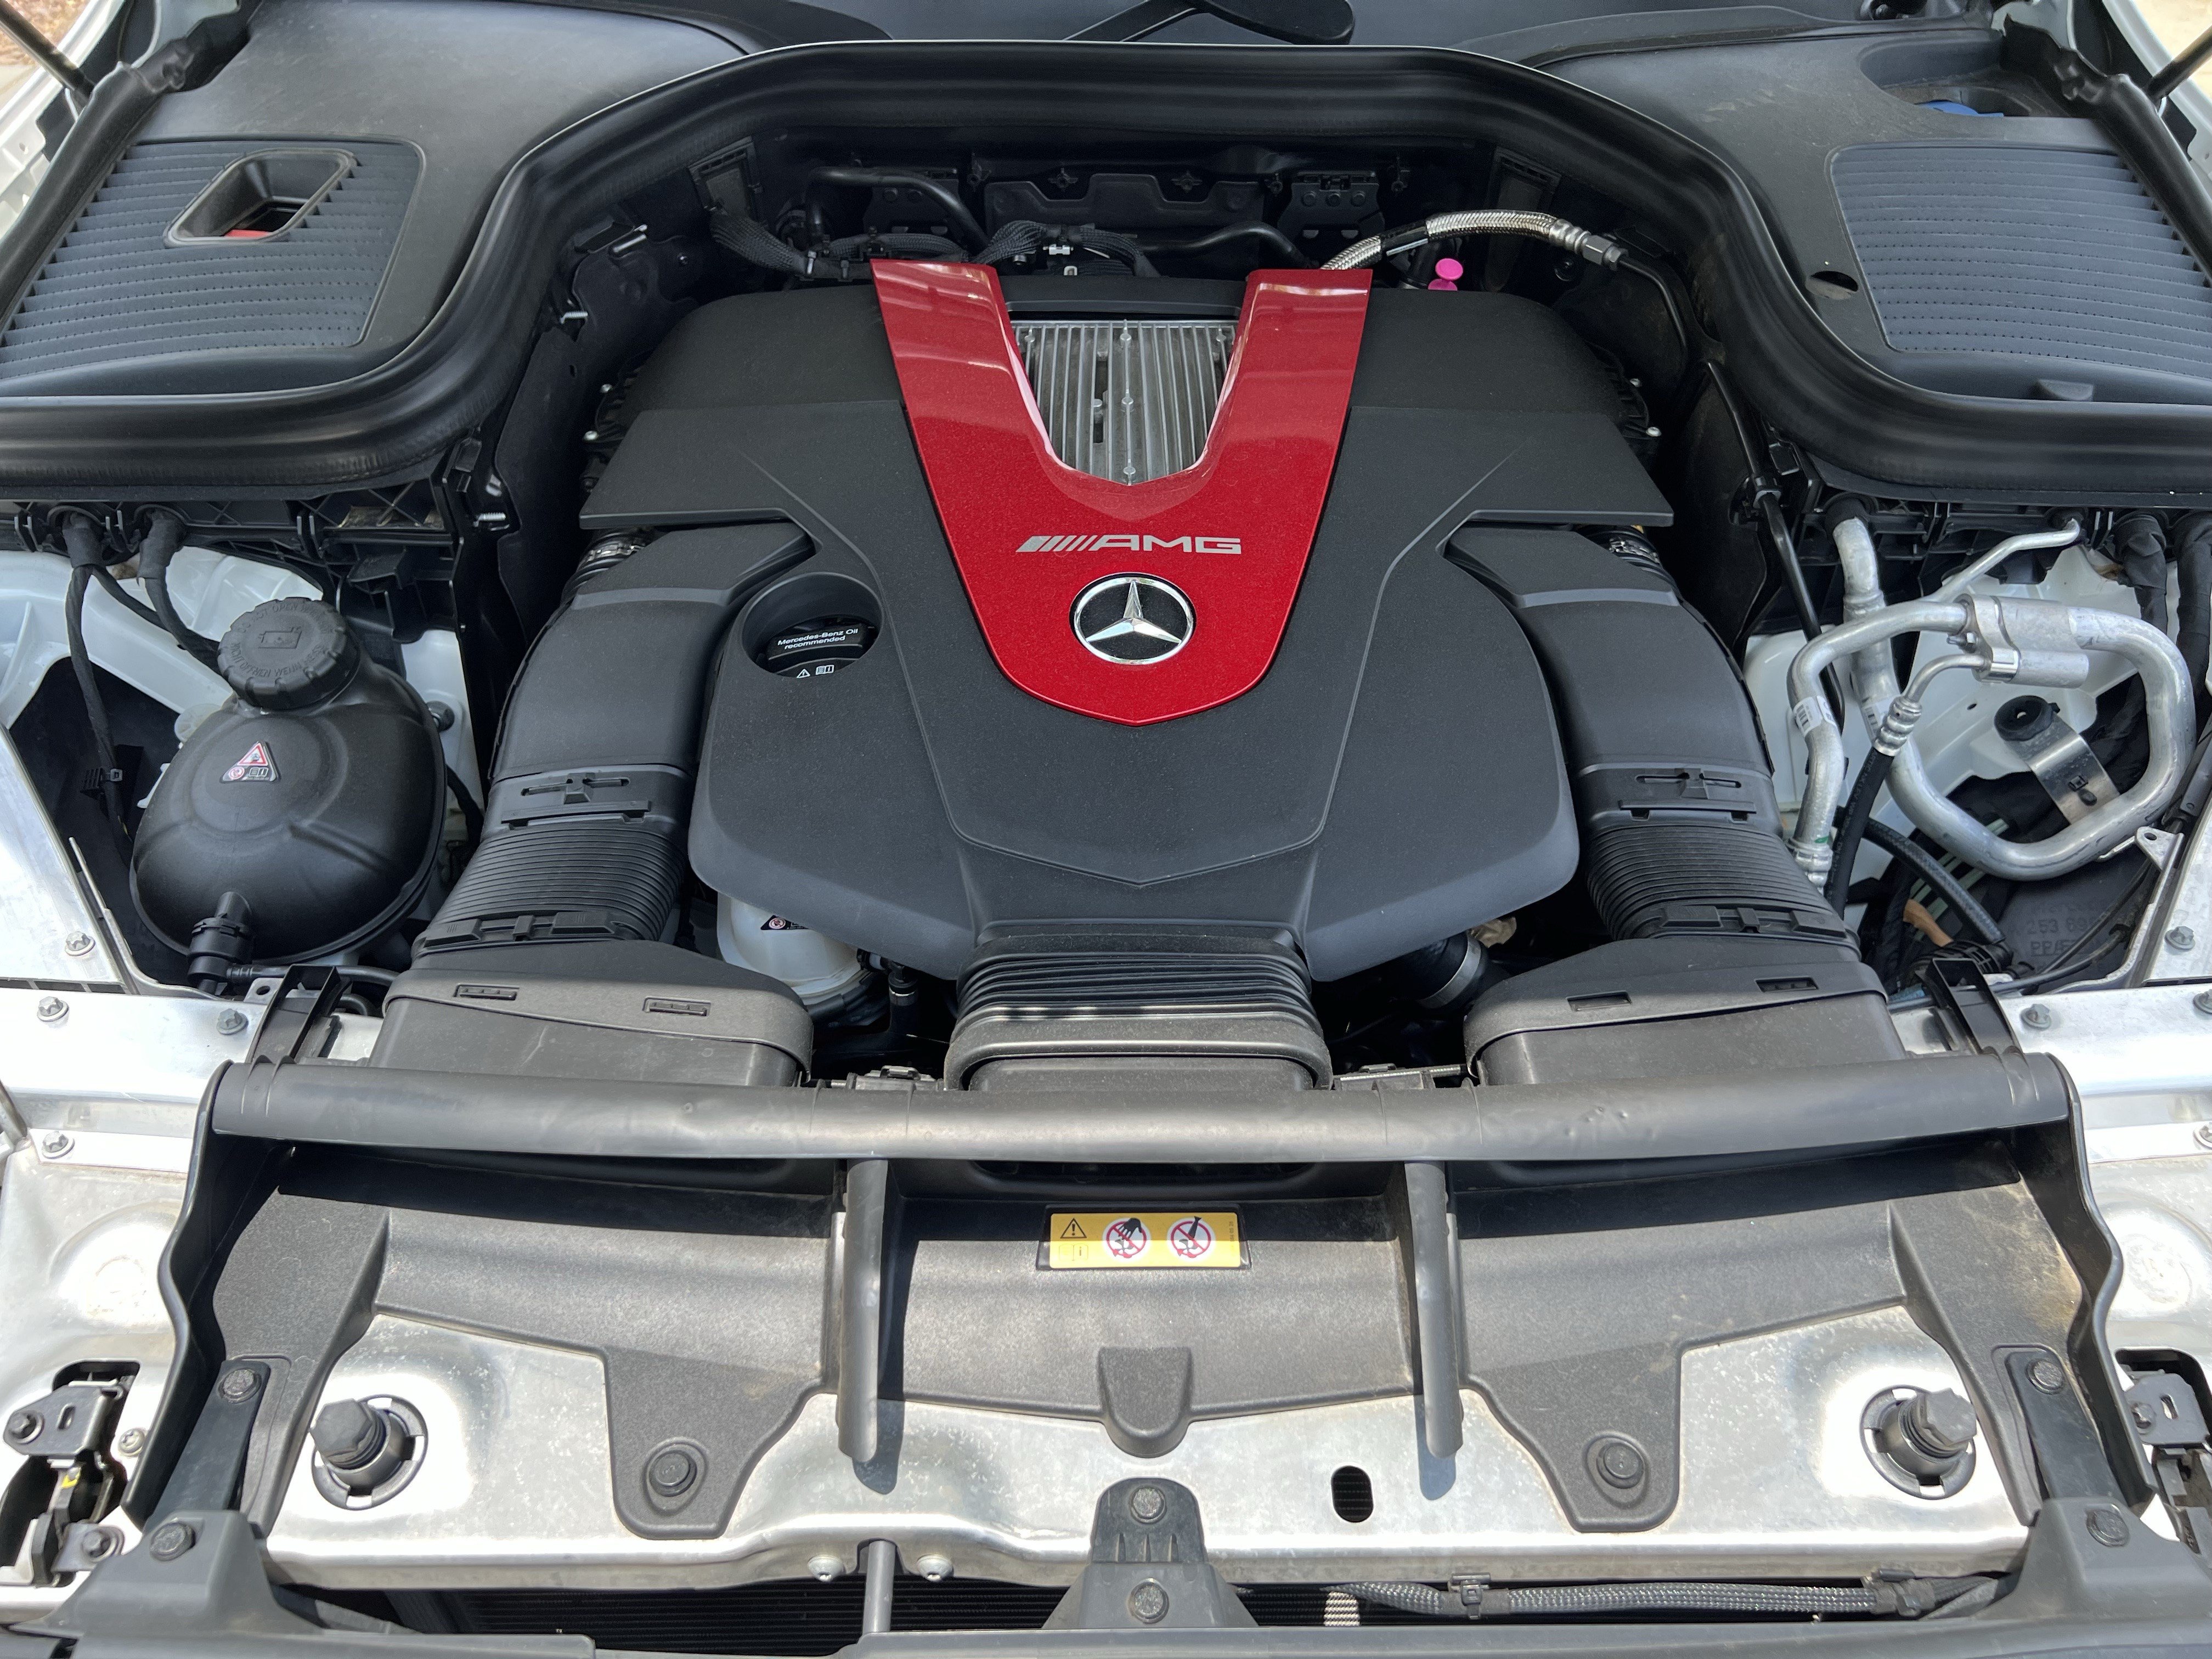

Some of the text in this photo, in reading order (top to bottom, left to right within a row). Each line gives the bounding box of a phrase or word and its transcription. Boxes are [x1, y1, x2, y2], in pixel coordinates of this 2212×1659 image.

[1088, 534, 1242, 555] AMG
[272, 603, 297, 613] OPEN
[777, 631, 844, 645] Mercedes-Benz
[784, 635, 845, 650] recommended
